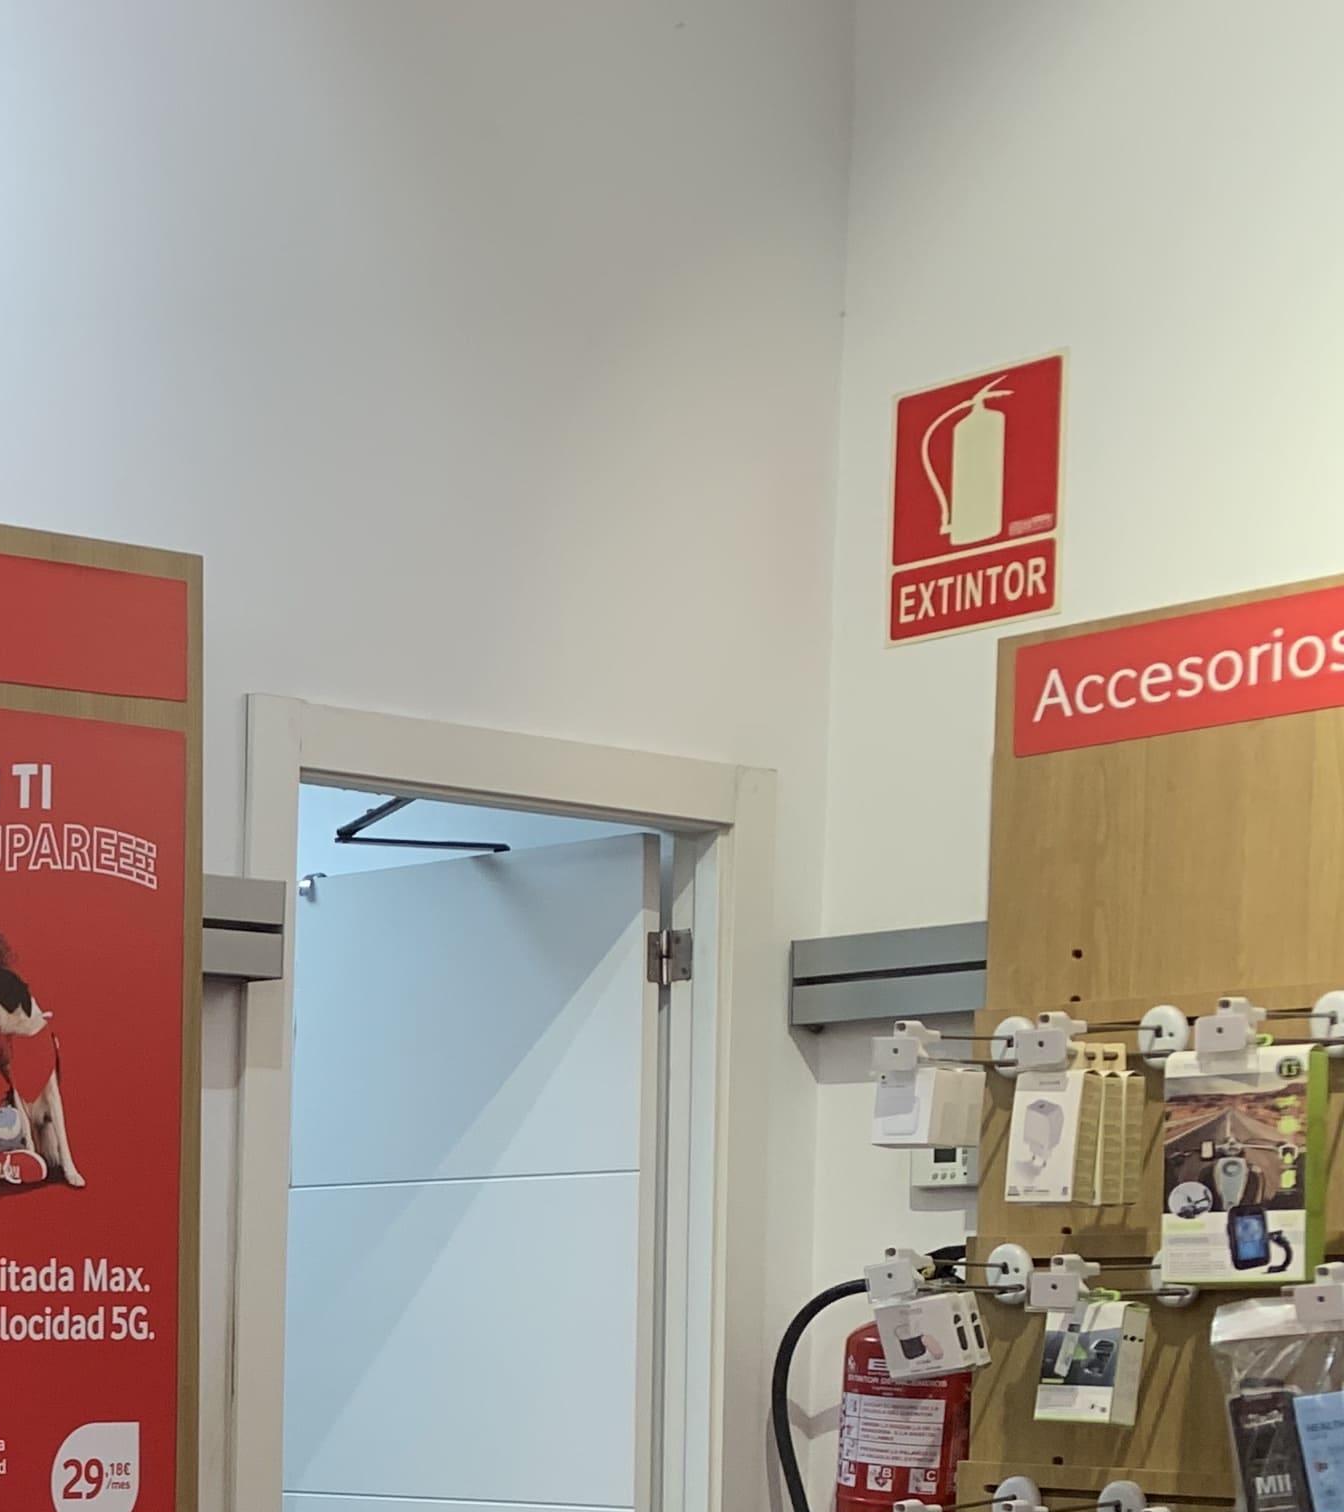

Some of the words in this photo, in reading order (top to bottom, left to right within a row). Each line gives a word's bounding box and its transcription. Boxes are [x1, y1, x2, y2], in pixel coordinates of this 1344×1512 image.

[898, 556, 1047, 625] EXTINTOR
[12, 763, 52, 810] TI
[83, 1258, 151, 1293] Max.
[111, 1306, 156, 1341] 5G.
